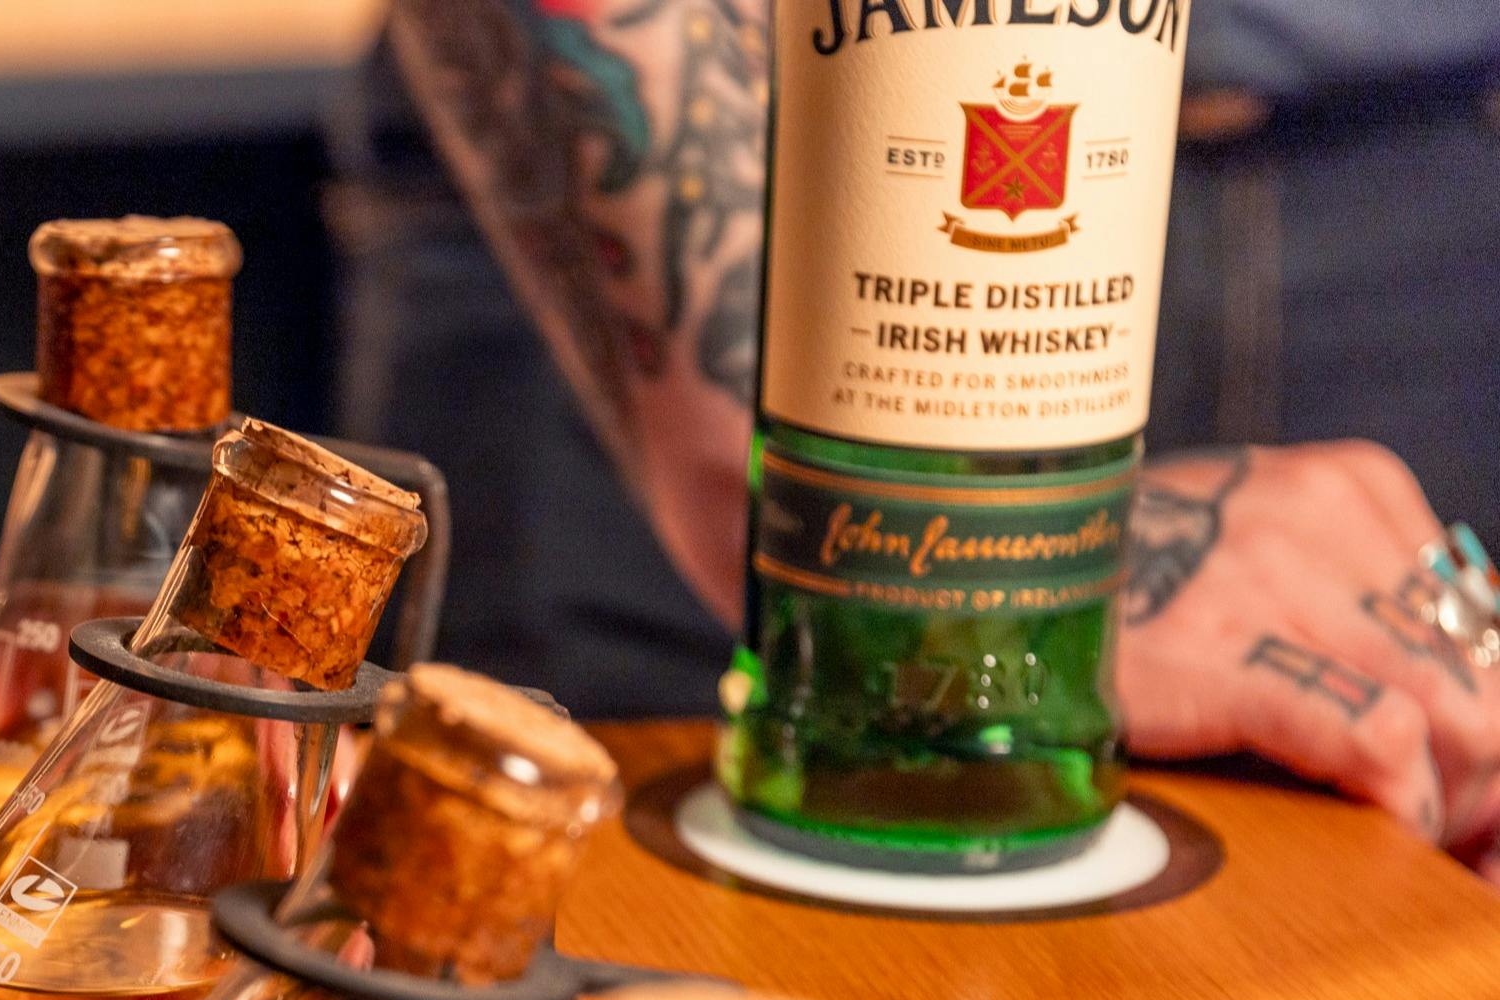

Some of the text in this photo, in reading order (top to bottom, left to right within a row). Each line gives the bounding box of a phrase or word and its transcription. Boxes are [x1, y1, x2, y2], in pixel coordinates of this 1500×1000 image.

[1084, 147, 1130, 170] 1780
[854, 271, 1135, 310] TRIPLE DISTILLED
[876, 321, 1114, 355] IRISH WHISKEY
[844, 361, 1131, 391] CRAFTED FOR SMOOTHNESS
[832, 387, 1133, 418] AT THE MIDLETON DISTILLERY
[820, 502, 911, 567] John
[853, 581, 967, 610] PRODUCT
[971, 588, 1006, 612] OF
